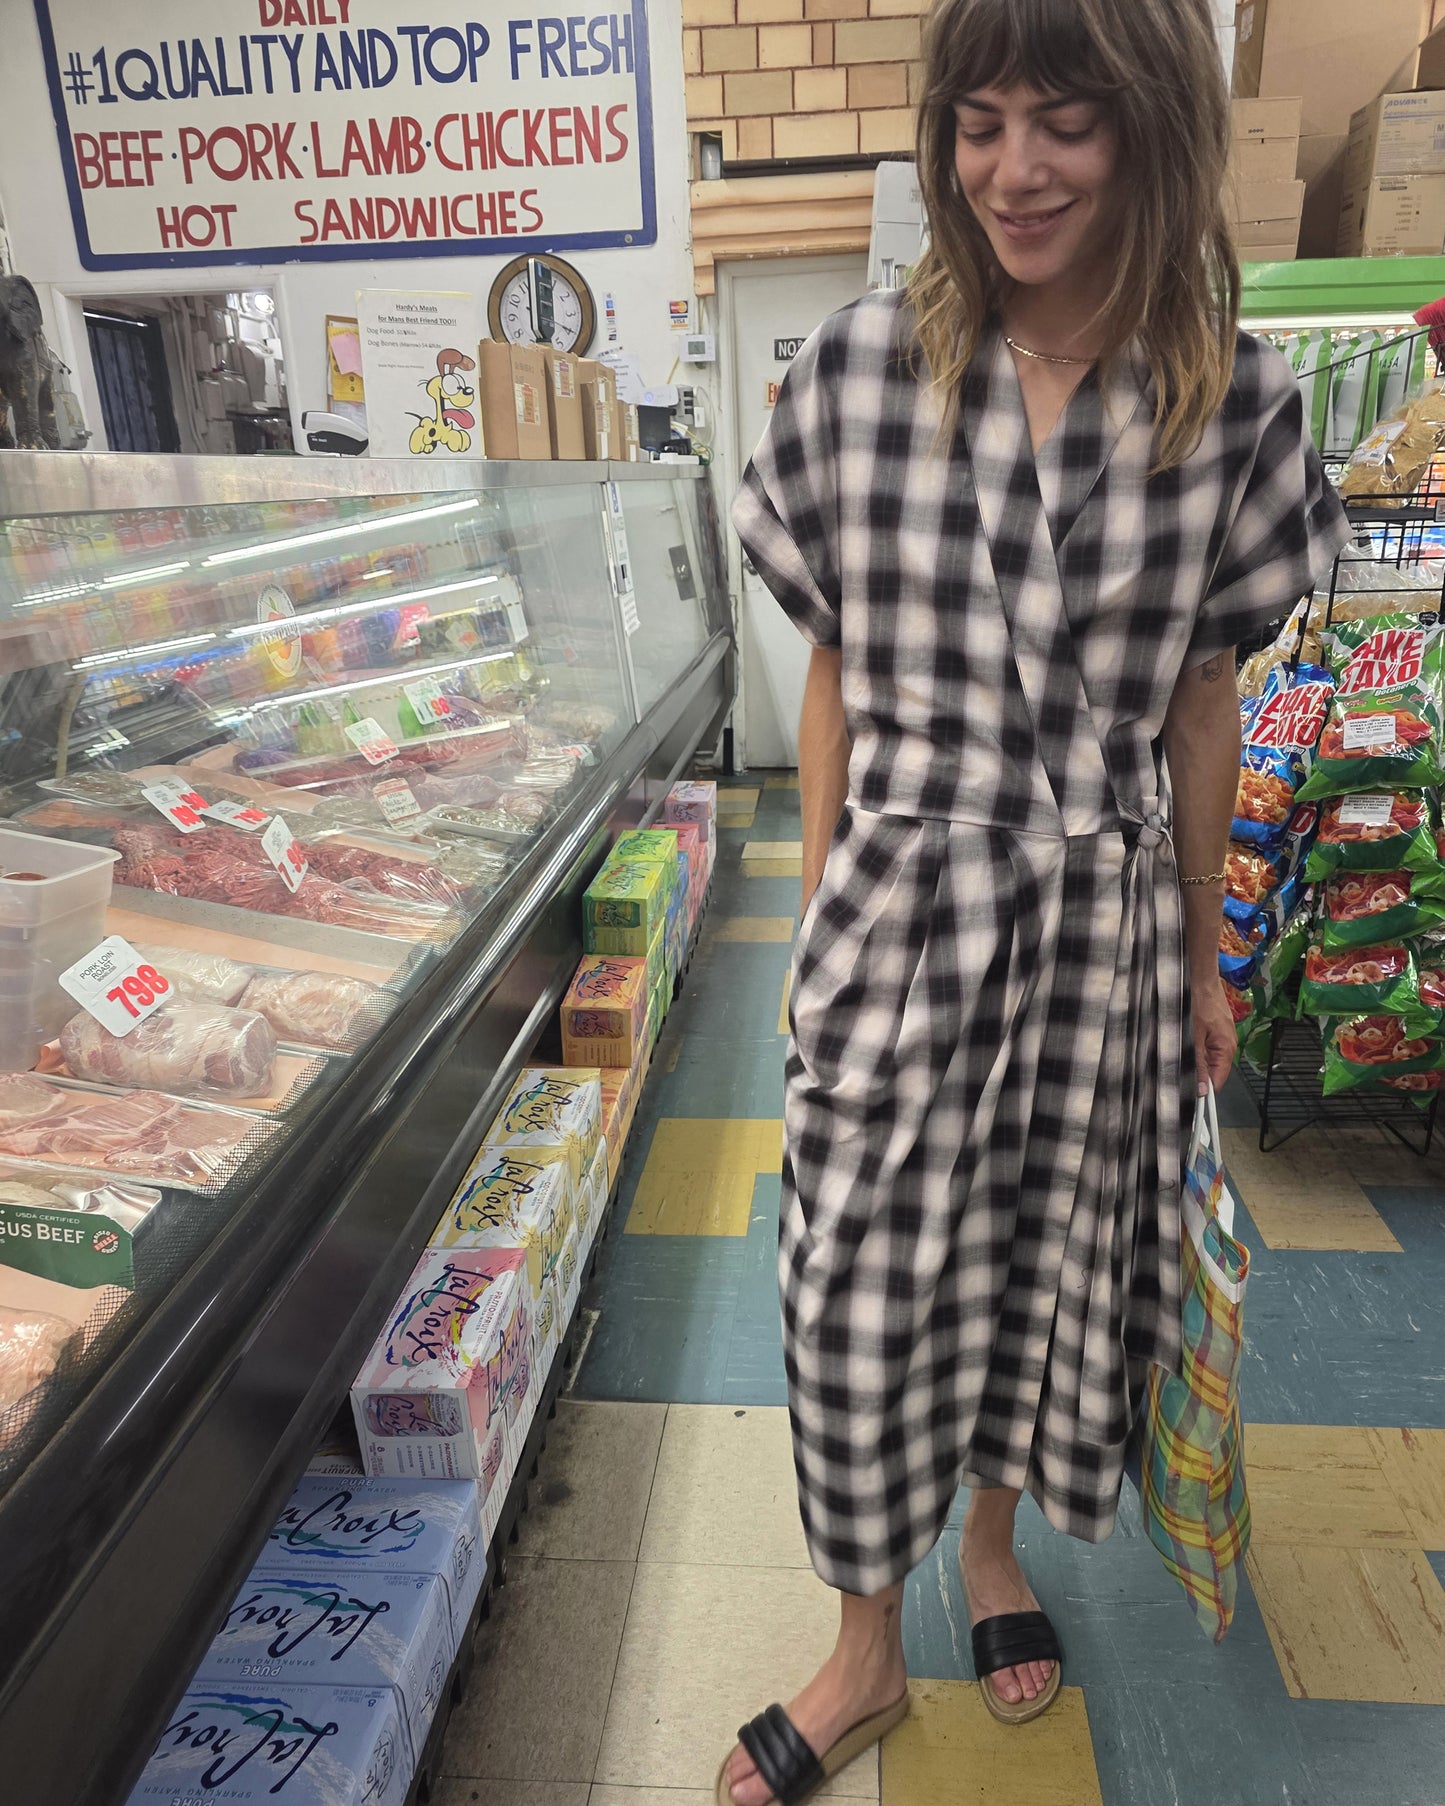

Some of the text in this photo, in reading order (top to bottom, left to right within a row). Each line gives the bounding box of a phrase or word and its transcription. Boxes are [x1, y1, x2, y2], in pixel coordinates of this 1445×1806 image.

[258, 0, 351, 27] DAILY
[508, 14, 634, 80] FRESH
[74, 103, 629, 189] BEEF PORK LAMB CHICKENS
[156, 189, 543, 249] HOT SANDWICHES
[560, 291, 570, 302] 2
[396, 304, 418, 312] Hardy's
[367, 327, 378, 335] Dog
[380, 327, 394, 335] Food
[368, 340, 380, 348] Dog
[381, 340, 398, 348] Bones
[779, 341, 796, 357] NO
[1337, 659, 1420, 694] TAXO
[1375, 681, 1417, 697] Botanero
[79, 950, 115, 980] PORK LOIN
[91, 960, 114, 980] ROAST
[106, 964, 169, 1018] 798
[39, 1215, 80, 1224] CERTIFIED
[36, 1223, 85, 1244] BEEF
[340, 1479, 374, 1487] PURE
[416, 1581, 424, 1590] 8
[216, 1656, 316, 1667] WATER SPARKLING
[241, 1665, 282, 1677] PURE
[367, 1698, 377, 1708] 8
[143, 1786, 252, 1799] WATER SPARKLING
